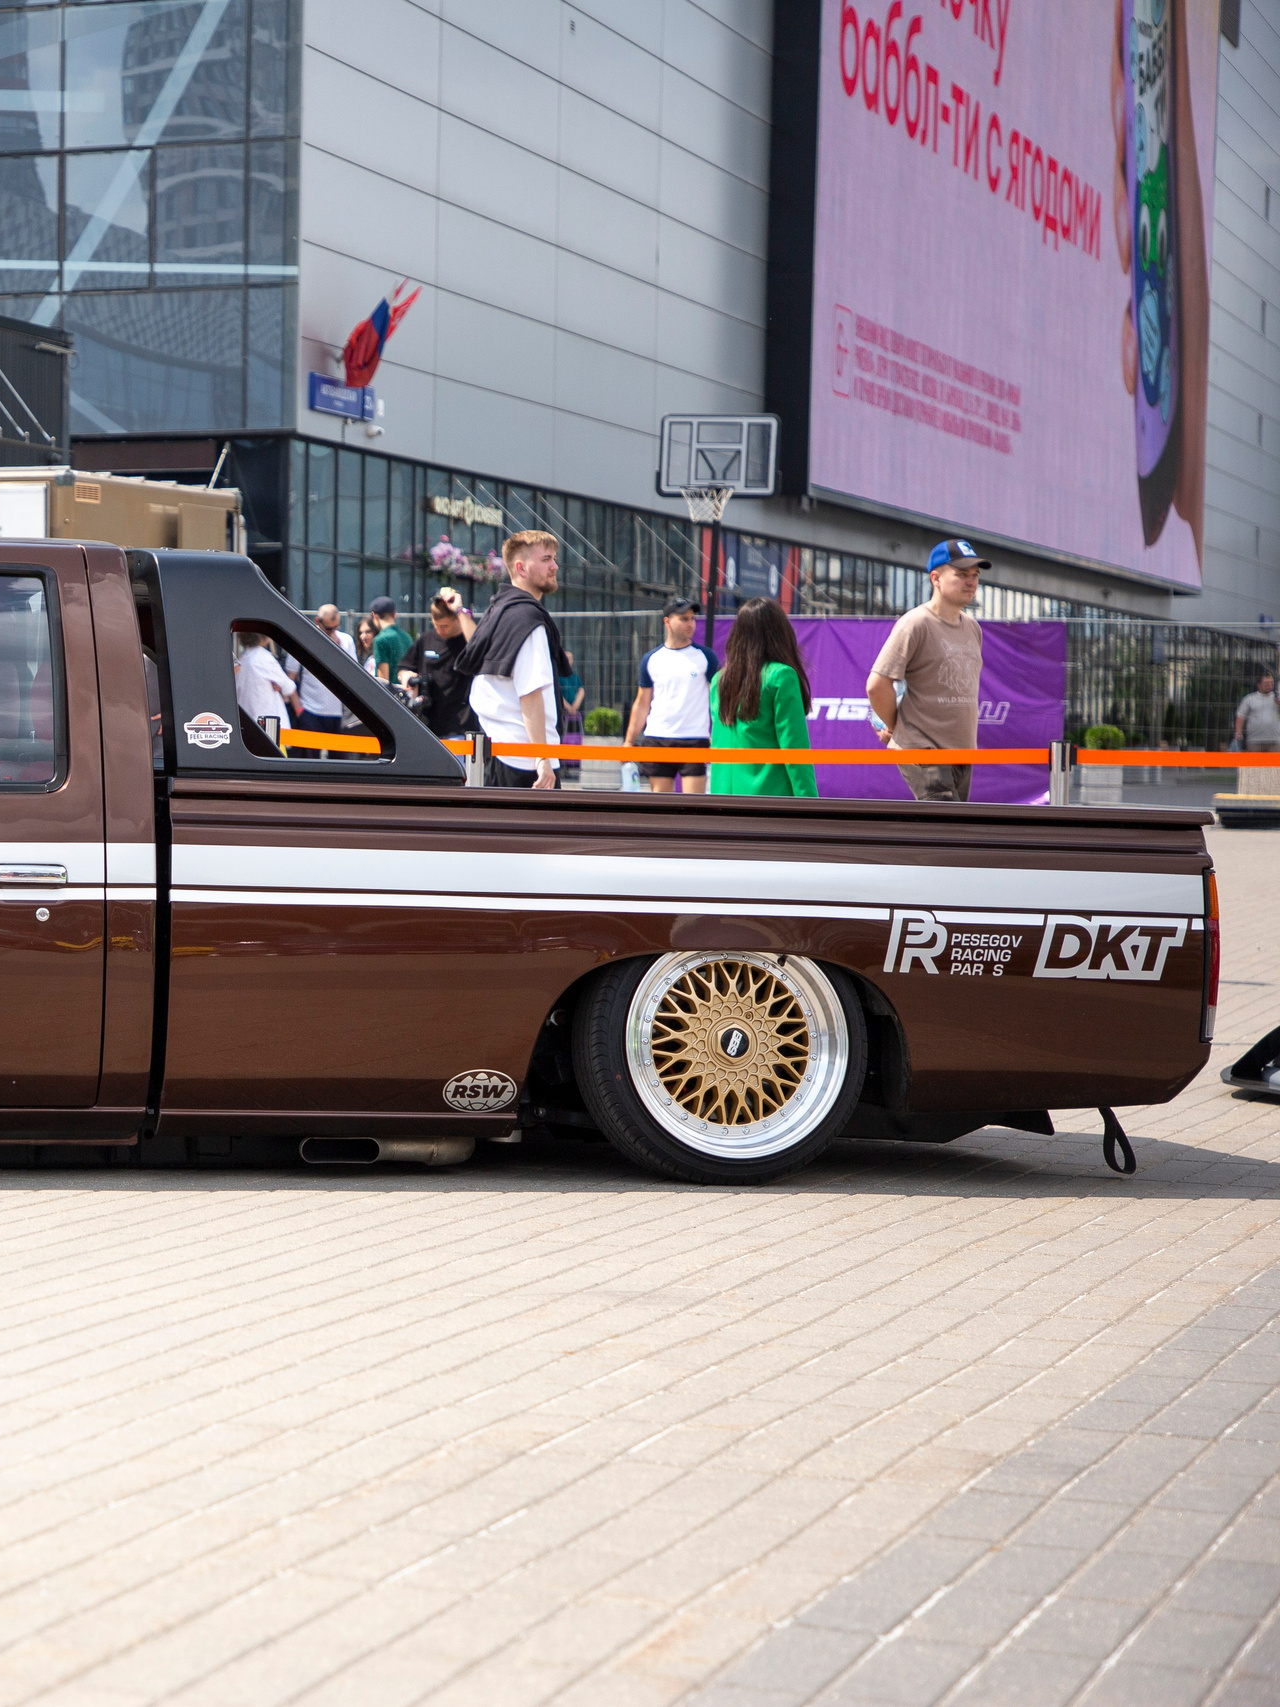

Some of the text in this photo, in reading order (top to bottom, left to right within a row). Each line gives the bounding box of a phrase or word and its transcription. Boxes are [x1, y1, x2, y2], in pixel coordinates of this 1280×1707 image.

[985, 111, 1003, 193] с
[1005, 127, 1102, 263] ягодами
[950, 933, 1023, 948] PESEGOV
[1035, 916, 1186, 978] DKT
[950, 948, 1012, 962] RACING
[726, 1029, 743, 1057] BBS
[451, 1084, 509, 1099] RSW
